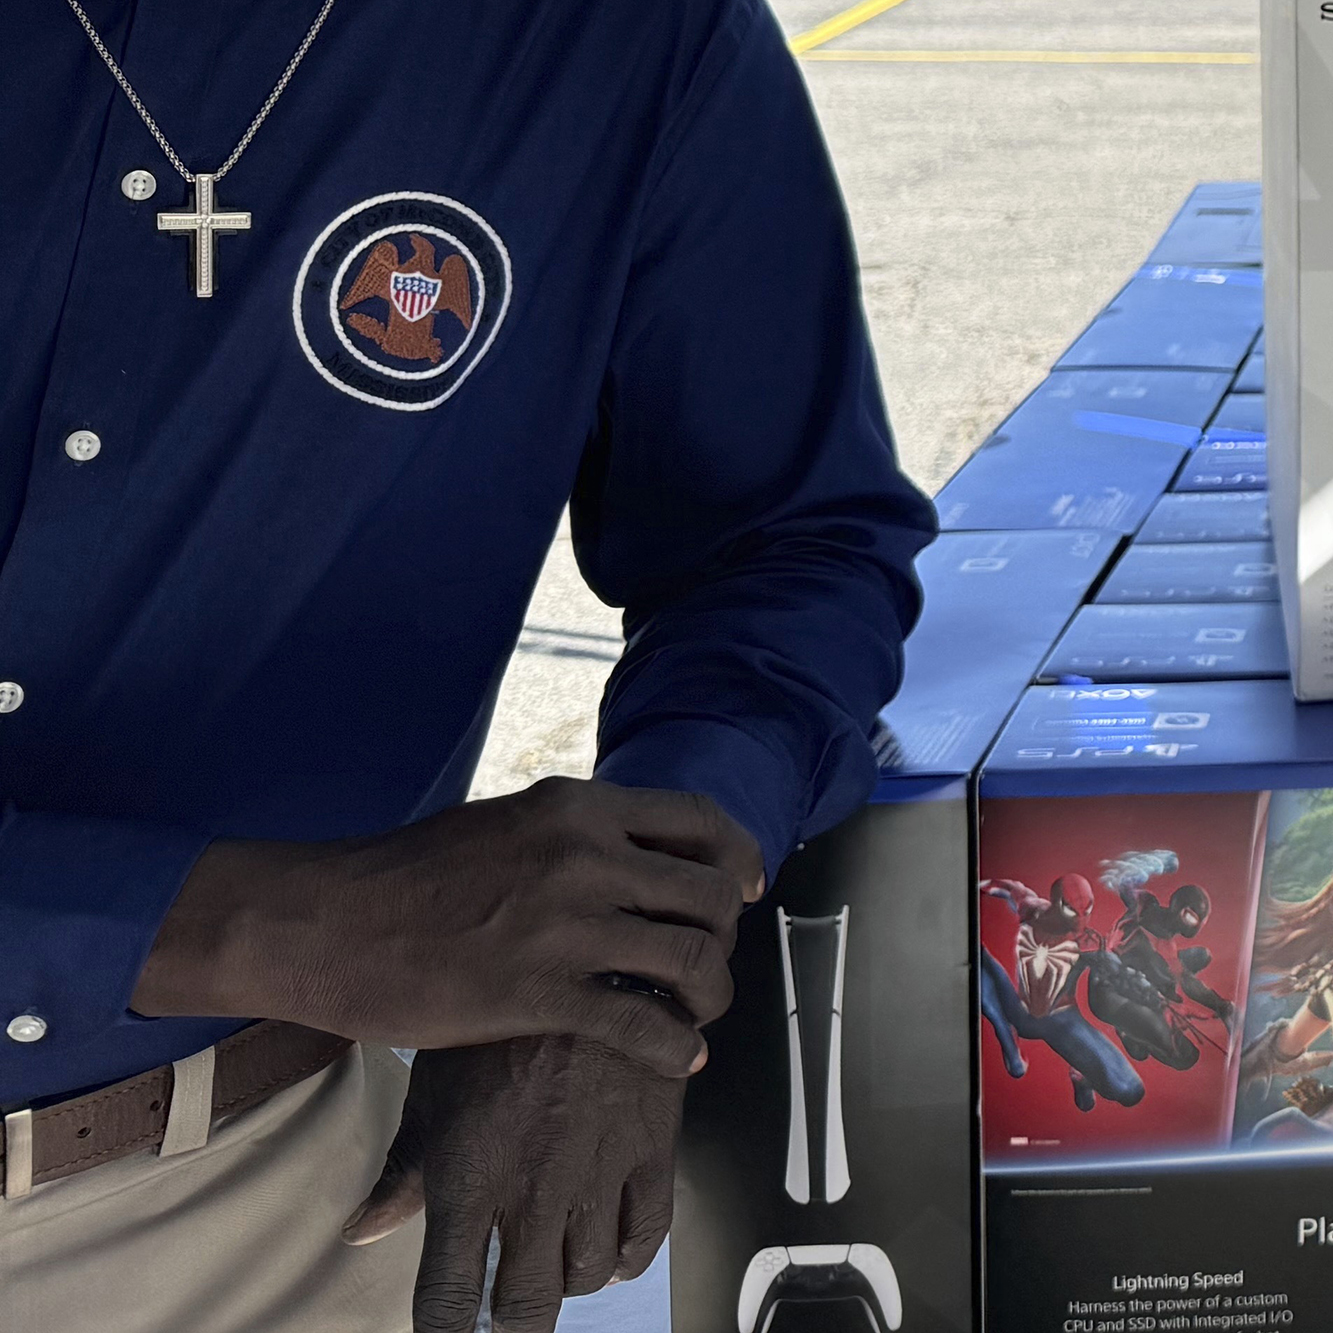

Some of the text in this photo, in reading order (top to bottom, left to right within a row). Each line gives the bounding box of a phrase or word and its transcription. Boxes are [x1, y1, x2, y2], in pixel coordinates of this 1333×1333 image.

[1112, 1270, 1244, 1294] Lightning Speed
[1068, 1293, 1288, 1314] Harness the power of a custom
[1063, 1319, 1094, 1333] CPU
[1097, 1317, 1124, 1331] and
[1128, 1316, 1156, 1330] SSD
[1159, 1315, 1190, 1329] with
[1193, 1311, 1267, 1329] Integrated
